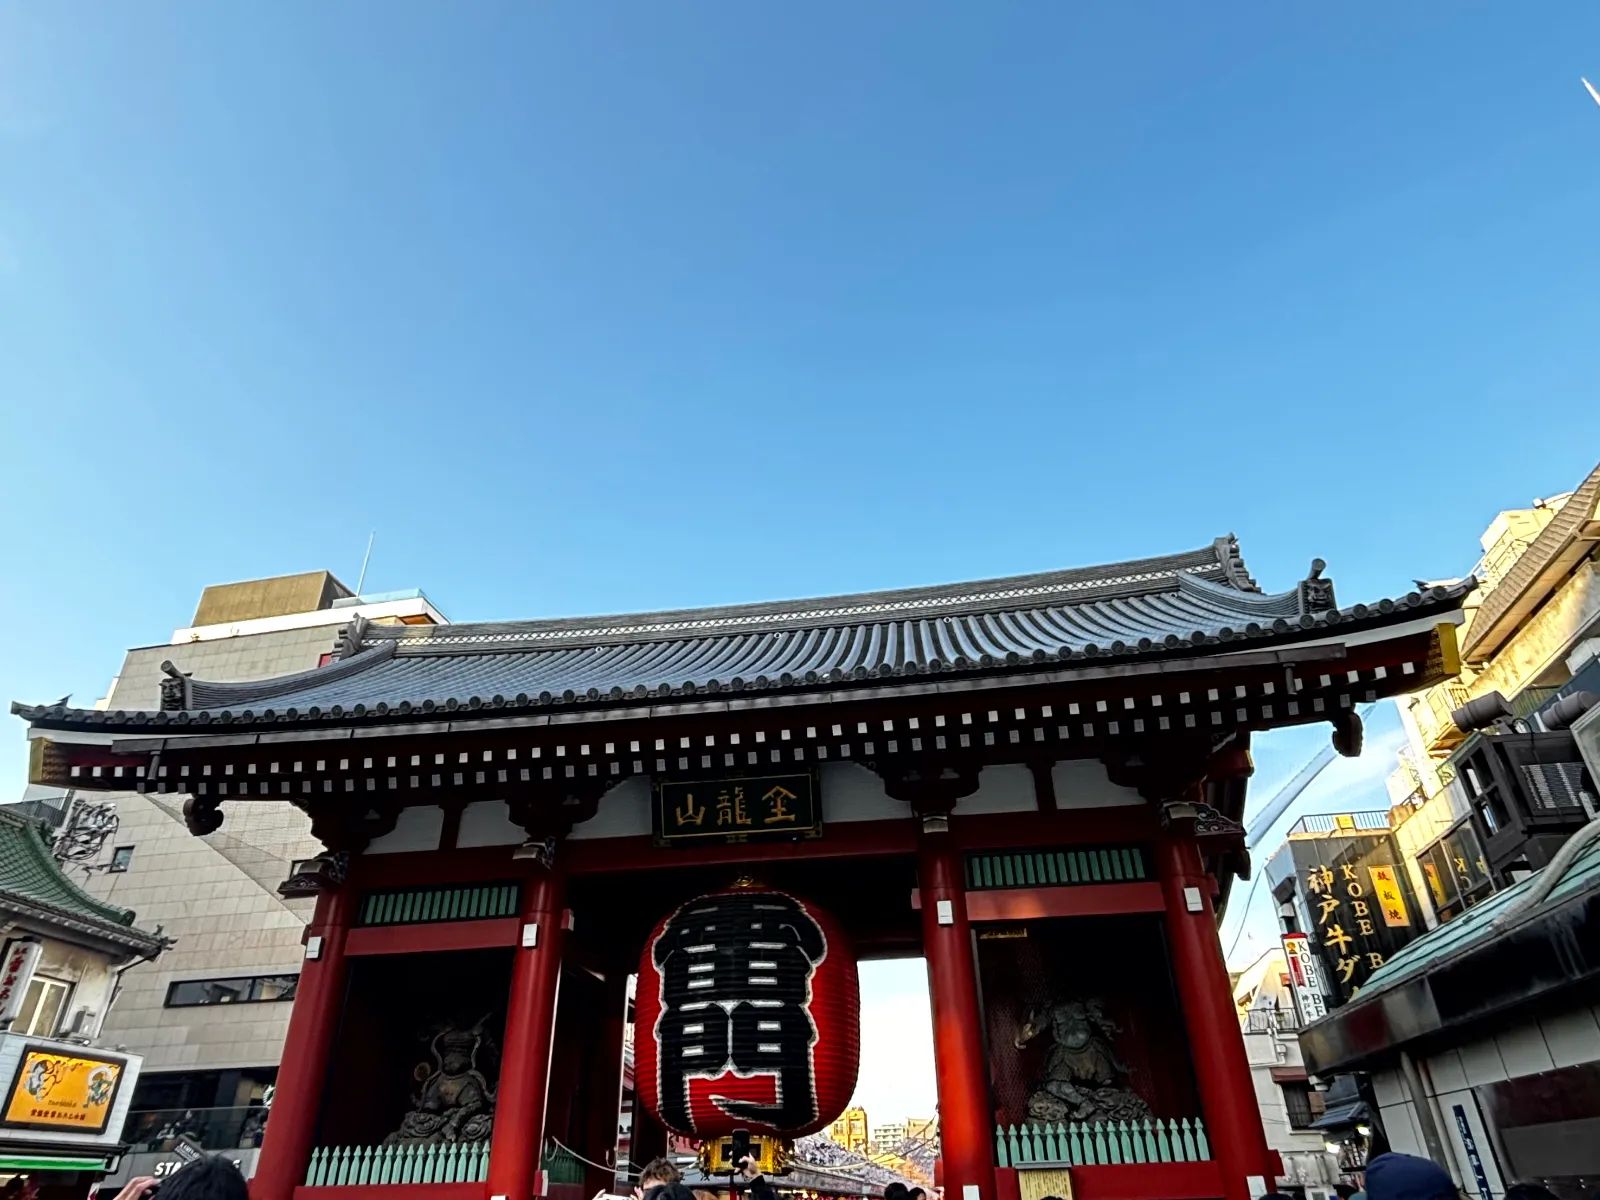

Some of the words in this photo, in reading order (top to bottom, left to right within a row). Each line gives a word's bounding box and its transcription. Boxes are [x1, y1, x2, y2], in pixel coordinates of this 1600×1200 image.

[1341, 864, 1374, 936] KOBE
[1298, 941, 1317, 988] KOBE
[652, 891, 828, 1133] 雷門
